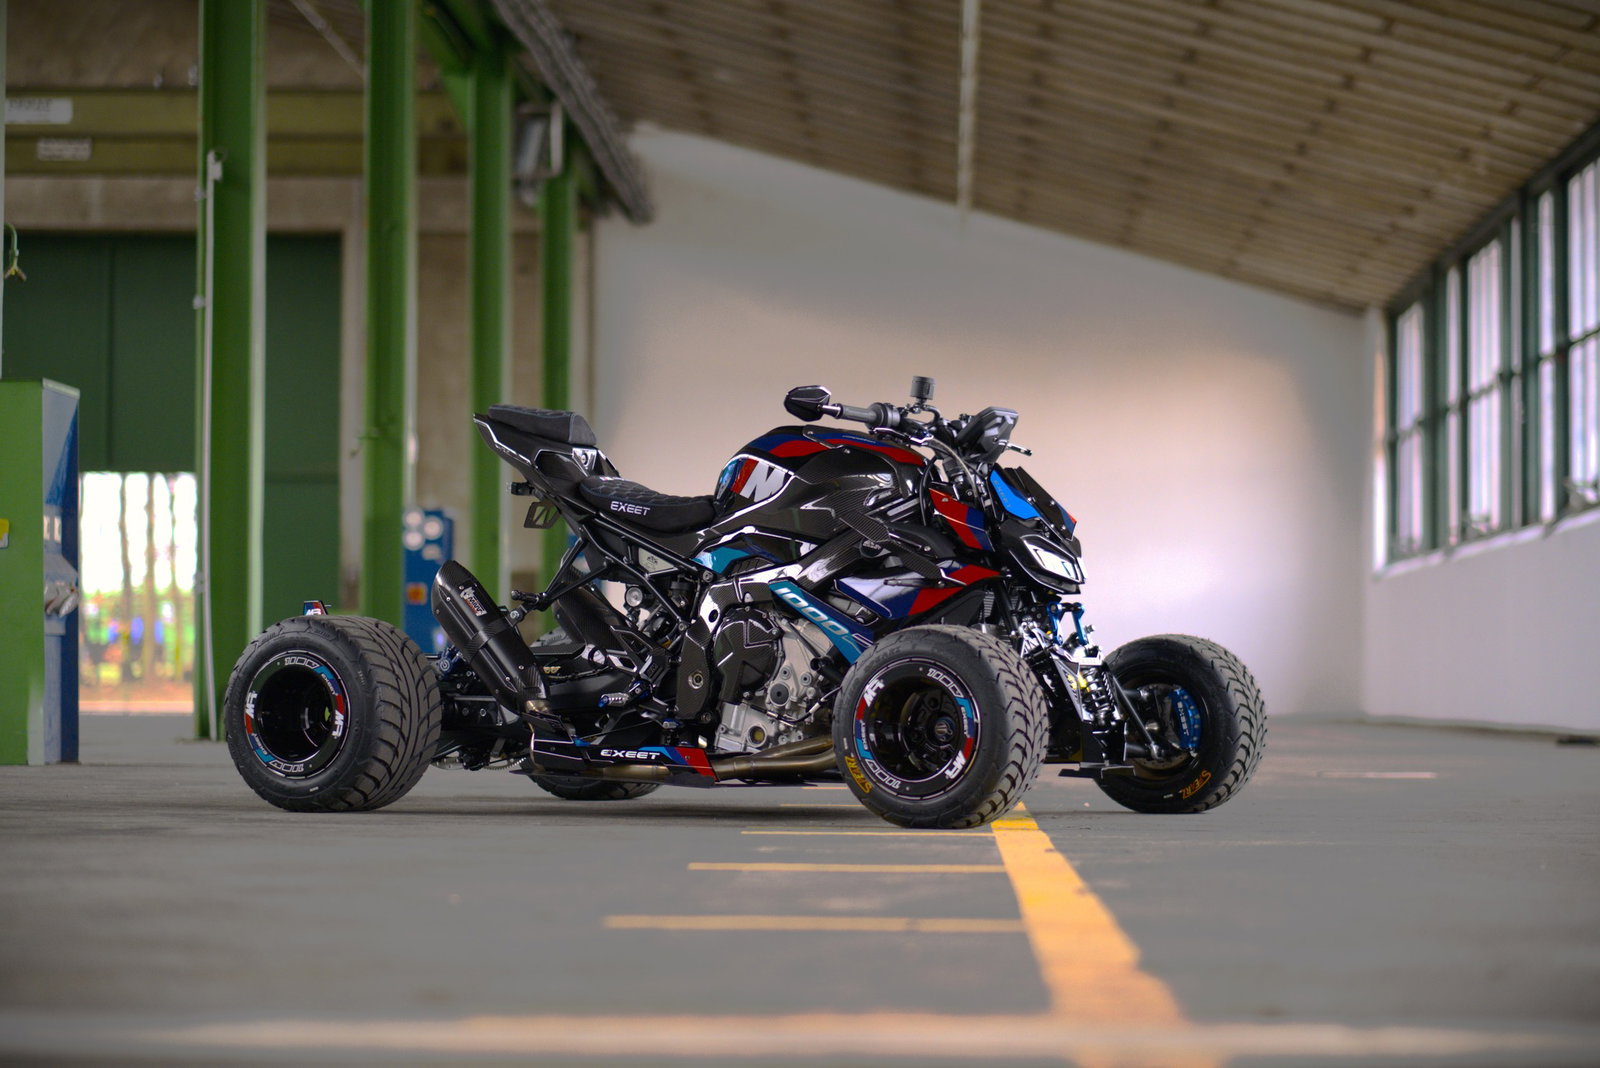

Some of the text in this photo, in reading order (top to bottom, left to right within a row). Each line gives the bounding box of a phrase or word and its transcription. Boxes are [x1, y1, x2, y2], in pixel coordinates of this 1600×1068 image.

[610, 501, 650, 516] EXEET
[927, 668, 964, 698] 1000
[1177, 701, 1189, 736] EXEET
[600, 749, 660, 760] EXEET
